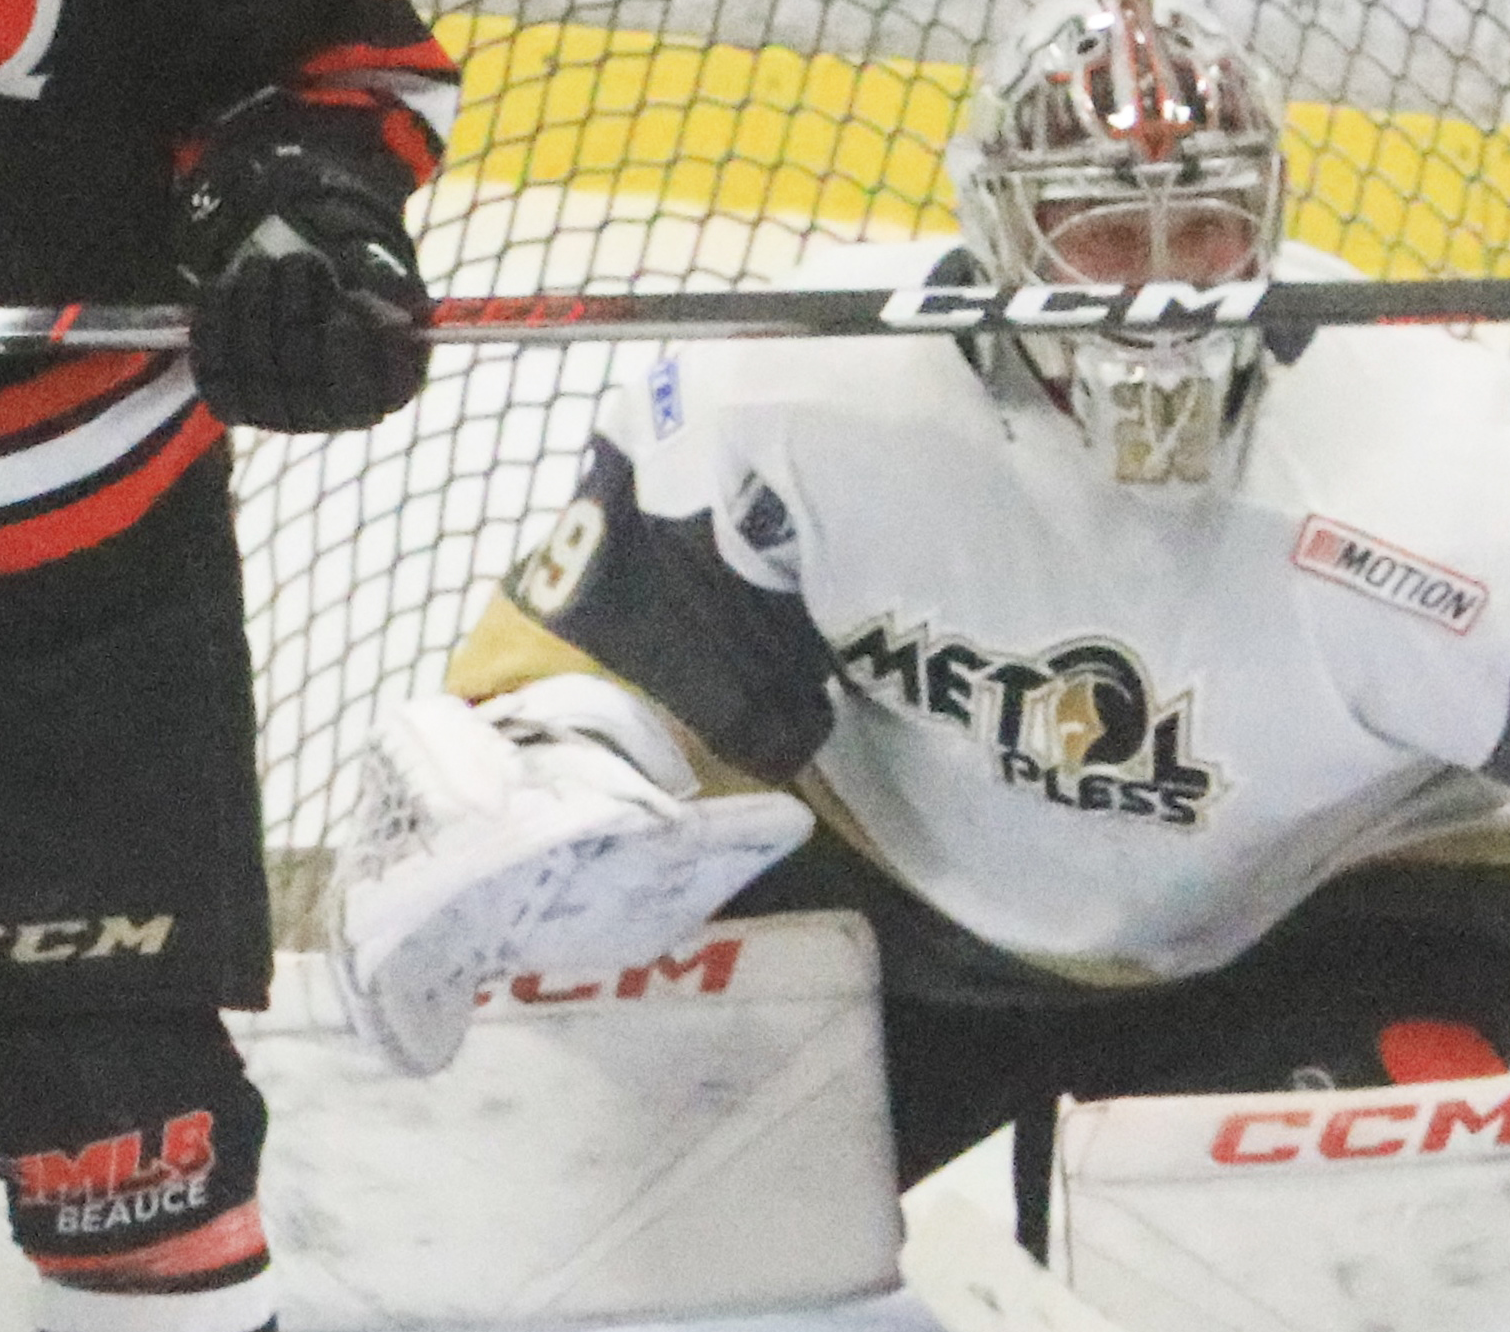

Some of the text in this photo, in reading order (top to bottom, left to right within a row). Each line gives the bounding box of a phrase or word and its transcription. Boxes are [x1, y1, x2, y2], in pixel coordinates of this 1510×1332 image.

[879, 279, 1272, 329] CCM
[1338, 540, 1479, 625] MOTION
[1000, 752, 1206, 826] PLESS
[56, 1179, 208, 1236] BEAUCE
